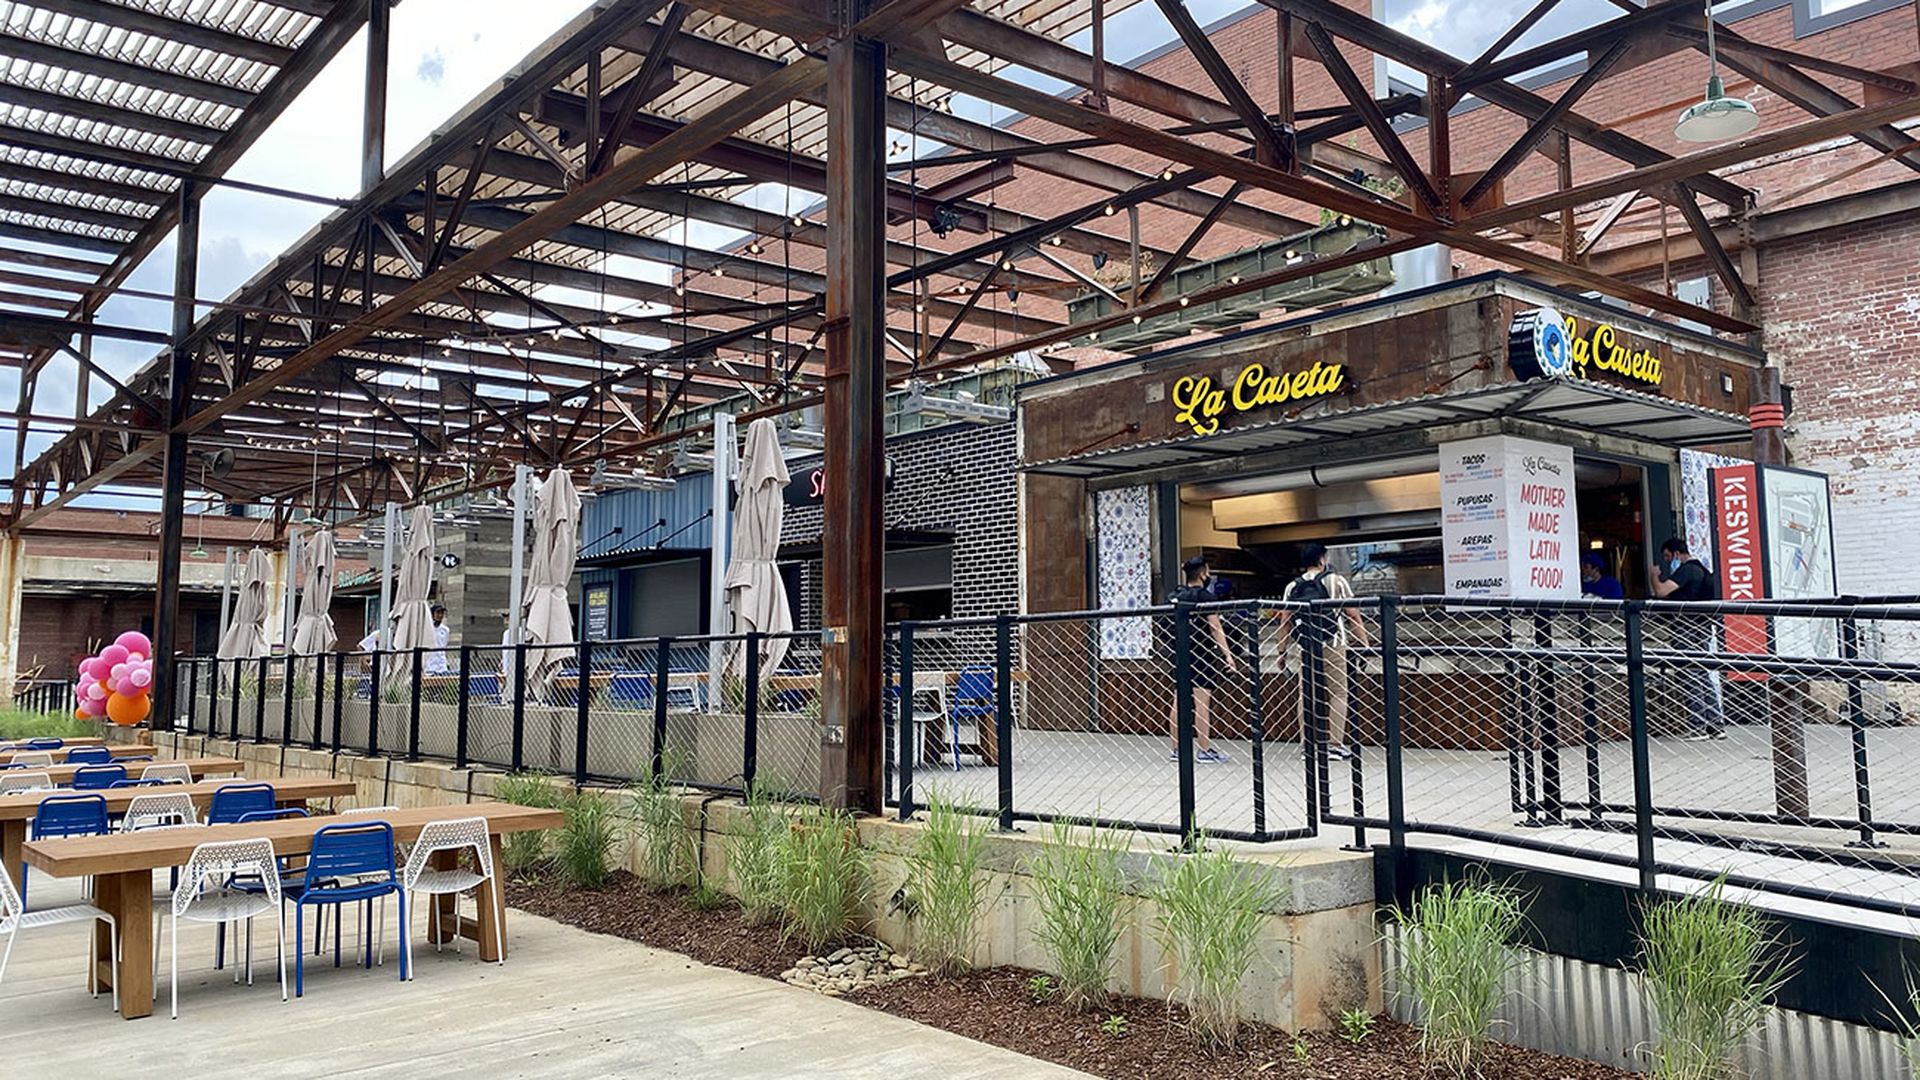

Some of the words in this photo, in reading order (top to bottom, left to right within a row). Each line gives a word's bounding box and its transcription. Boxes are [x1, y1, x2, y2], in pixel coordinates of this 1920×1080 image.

[1592, 323, 1662, 385] Caseta
[1172, 376, 1226, 435] La
[1232, 361, 1344, 411] Caseta
[1462, 453, 1485, 465] TACOS
[1457, 493, 1493, 506] PUPUSAS
[1520, 483, 1566, 508] MOTHER
[1528, 511, 1560, 534] MADE
[1461, 534, 1493, 546] AREPAS
[1723, 477, 1754, 600] KESWICK
[1529, 539, 1561, 561] LATIN
[1455, 577, 1503, 590] EMPANADAS
[1530, 567, 1563, 589] FOOD!
